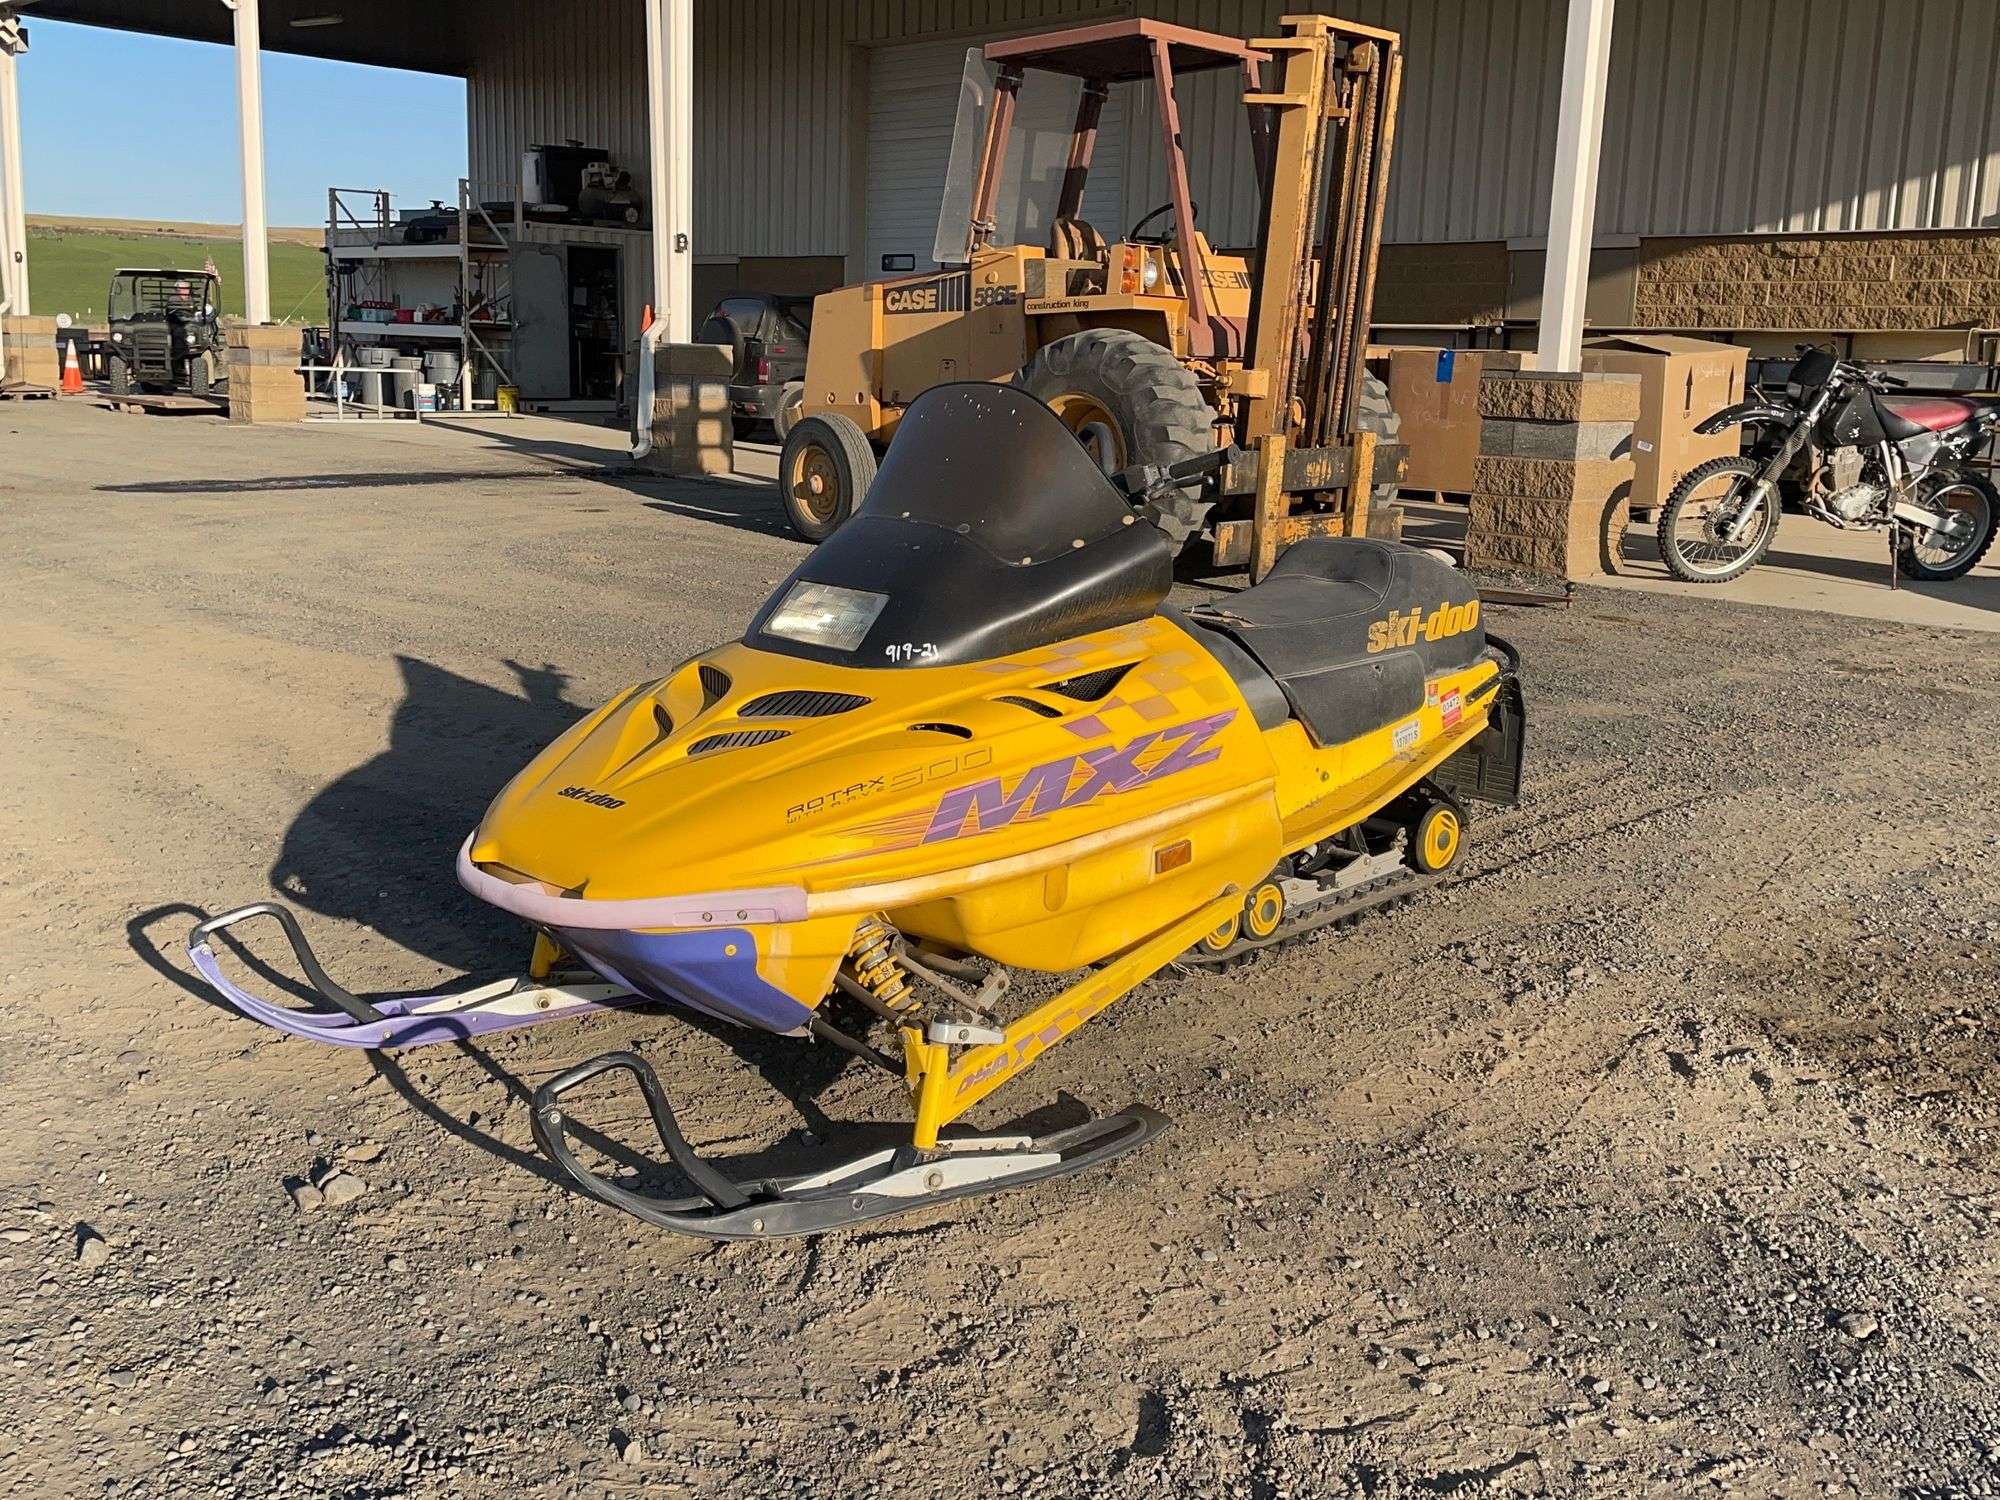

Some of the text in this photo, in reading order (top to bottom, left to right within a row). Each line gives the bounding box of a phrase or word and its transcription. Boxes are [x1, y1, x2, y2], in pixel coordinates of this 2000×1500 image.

[1201, 270, 1241, 289] ASE
[886, 284, 1018, 312] CASE 586E
[1026, 299, 1090, 311] construction king
[1366, 599, 1480, 654] ski-doo
[885, 642, 939, 663] 919-21
[786, 746, 992, 818] ROTAX 500
[920, 708, 1238, 845] MXZ
[786, 807, 824, 825] WITH
